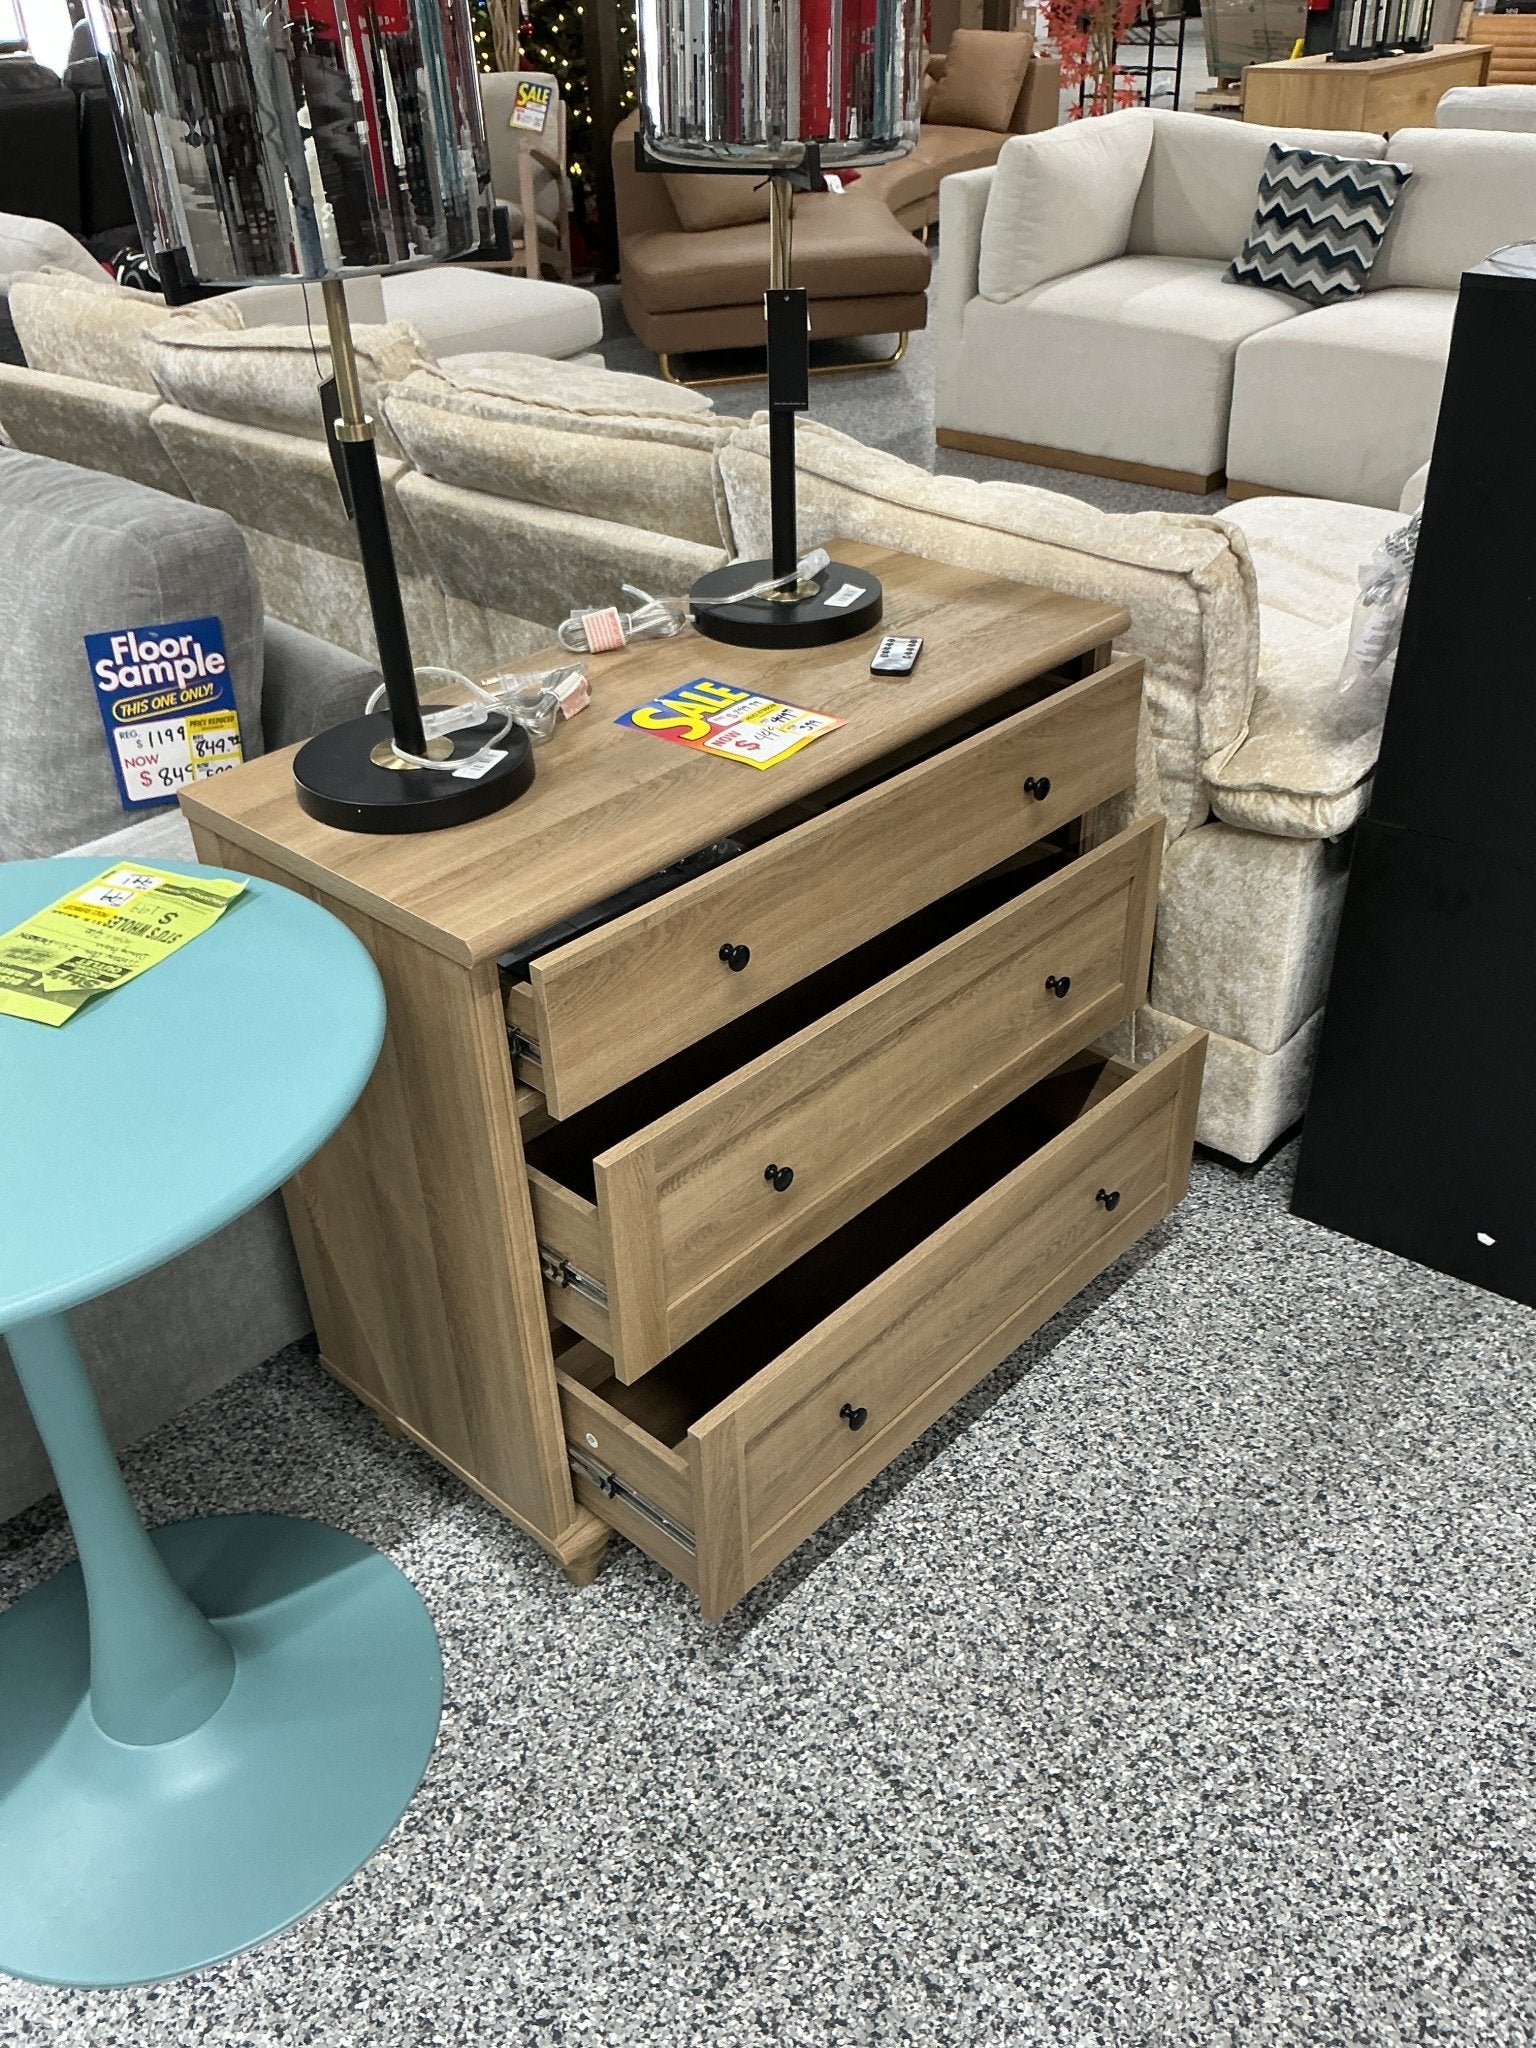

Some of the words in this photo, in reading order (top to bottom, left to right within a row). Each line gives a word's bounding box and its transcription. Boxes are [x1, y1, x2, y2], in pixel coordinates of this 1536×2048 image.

[517, 83, 550, 105] SALE
[110, 631, 193, 665] Floor
[95, 643, 226, 692] Sample
[120, 700, 149, 717] THIS
[152, 692, 177, 709] ONE
[180, 683, 214, 702] ONLY!
[631, 682, 750, 741] SALE
[711, 730, 741, 746] NOW
[124, 754, 159, 769] NOW
[140, 770, 152, 787] $
